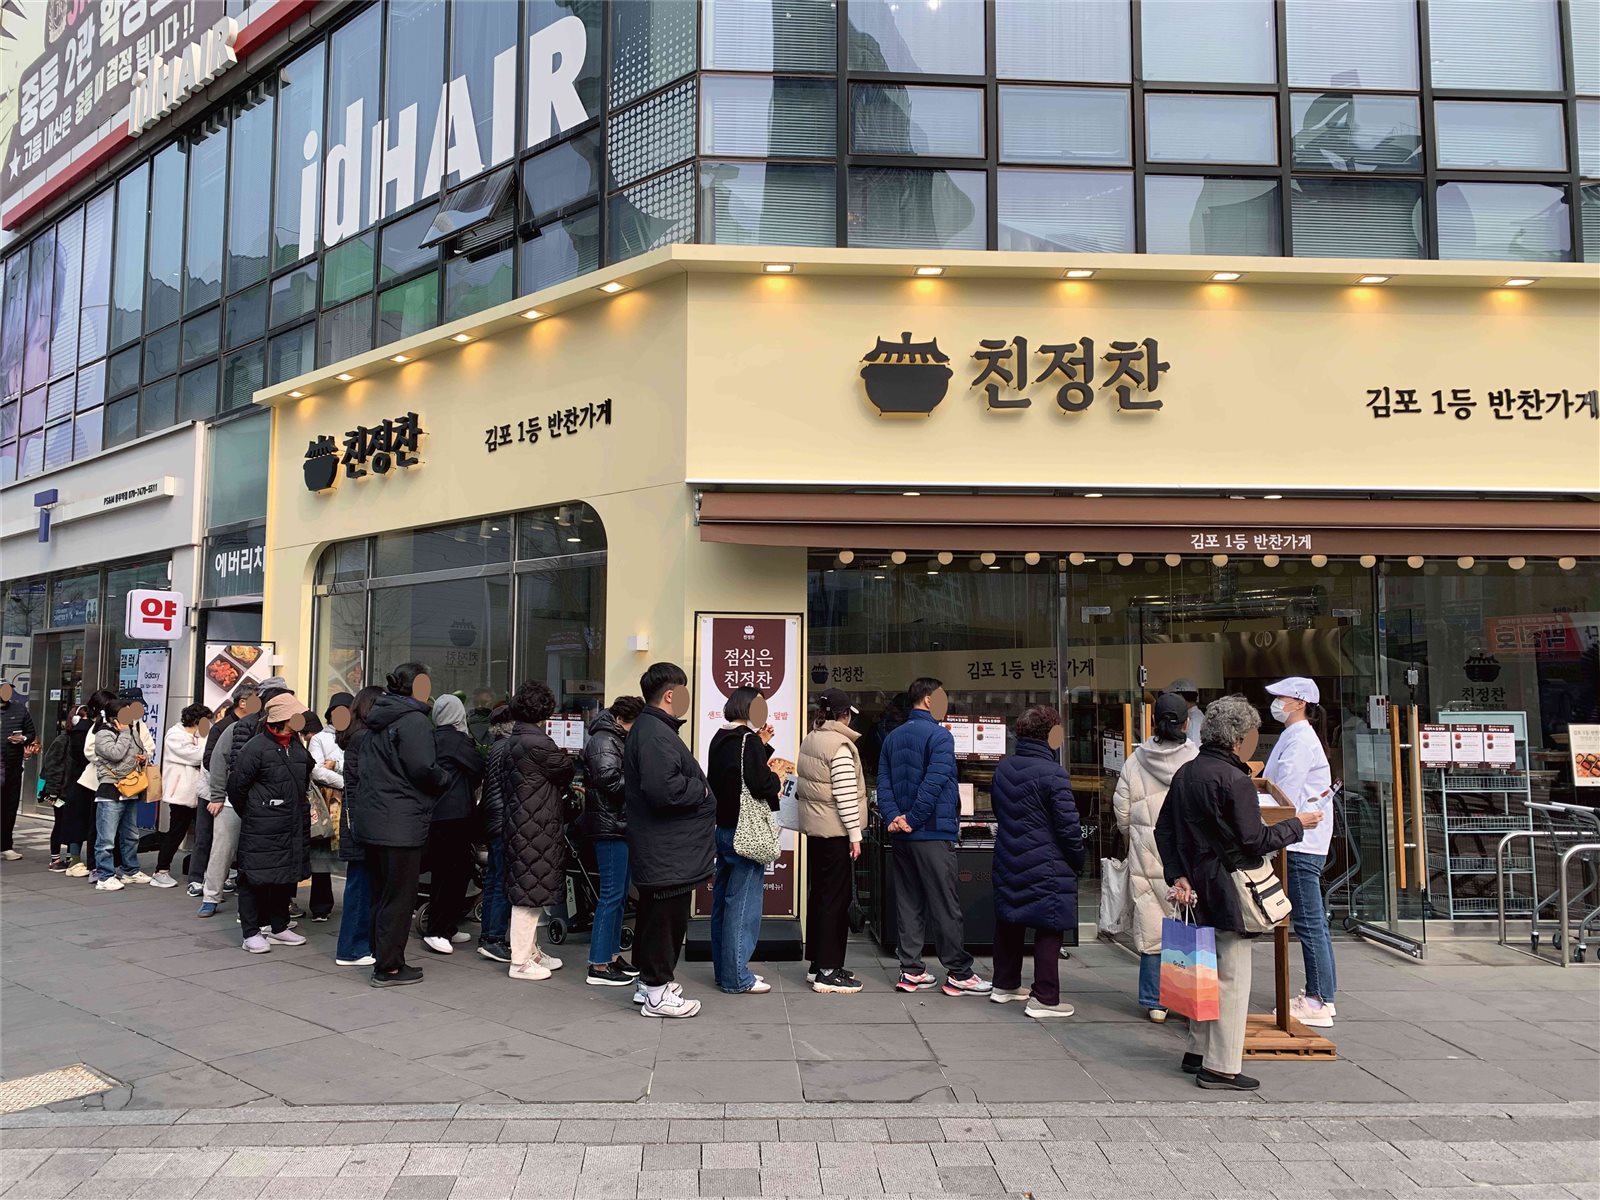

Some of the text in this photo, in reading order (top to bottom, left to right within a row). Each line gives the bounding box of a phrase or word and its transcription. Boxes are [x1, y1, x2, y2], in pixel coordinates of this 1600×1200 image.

[20, 54, 58, 136] 중등
[63, 14, 95, 99] 2관
[128, 16, 238, 138] idHAIR
[22, 131, 44, 171] 고등
[45, 104, 72, 152] 내신은
[106, 46, 133, 92] 결정
[299, 15, 590, 260] idHAIR
[970, 336, 1171, 412] 친정찬
[1366, 387, 1599, 420] 김포 1등 반찬가게
[484, 398, 613, 453] 김포 1등 반찬가게
[342, 412, 422, 479] 친정찬
[1190, 533, 1312, 550] 김포 1등 반찬가게
[140, 598, 177, 632] 약
[724, 648, 774, 667] 점심은
[831, 666, 865, 682] 친정찬
[967, 658, 1095, 680] 김포 1등 반찬가게
[724, 670, 773, 689] 친정찬
[1461, 687, 1506, 702] 친정찬
